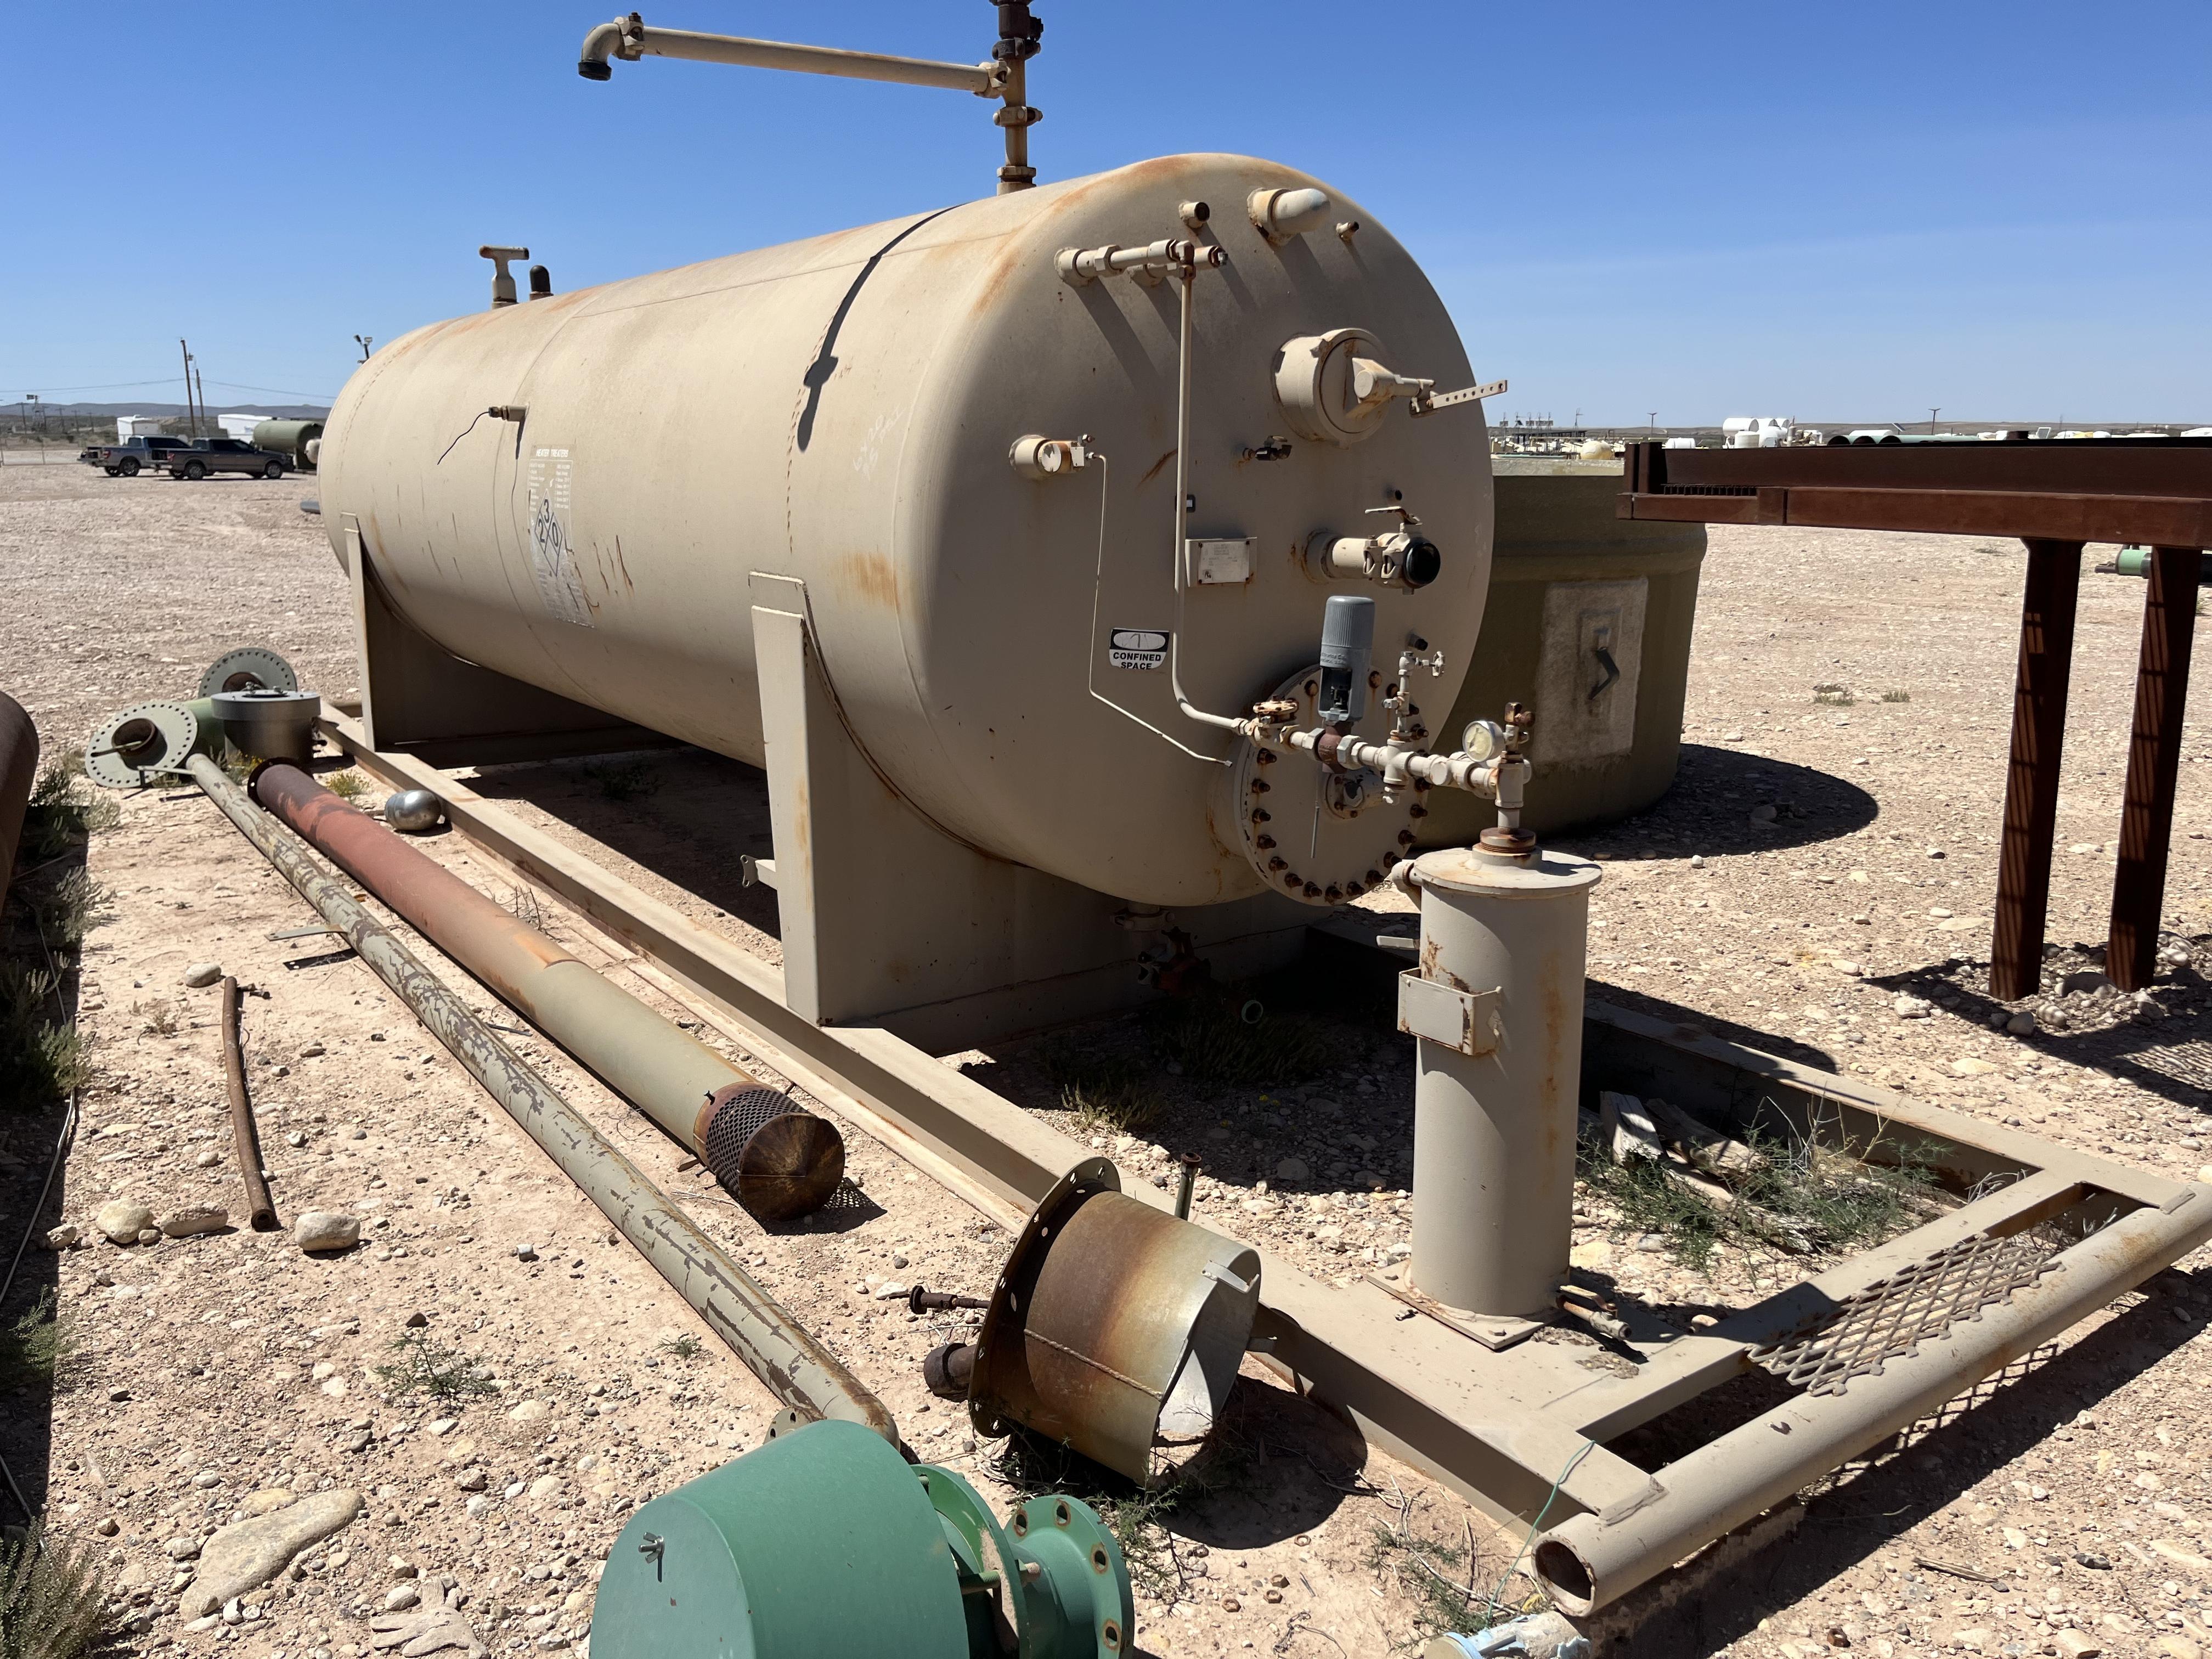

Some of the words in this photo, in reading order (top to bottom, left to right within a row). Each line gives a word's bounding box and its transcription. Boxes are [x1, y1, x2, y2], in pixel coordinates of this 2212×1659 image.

[544, 499, 549, 523] 3
[538, 518, 545, 543] 2
[1113, 652, 1161, 662] CONFINED
[1121, 661, 1153, 670] SPACE
